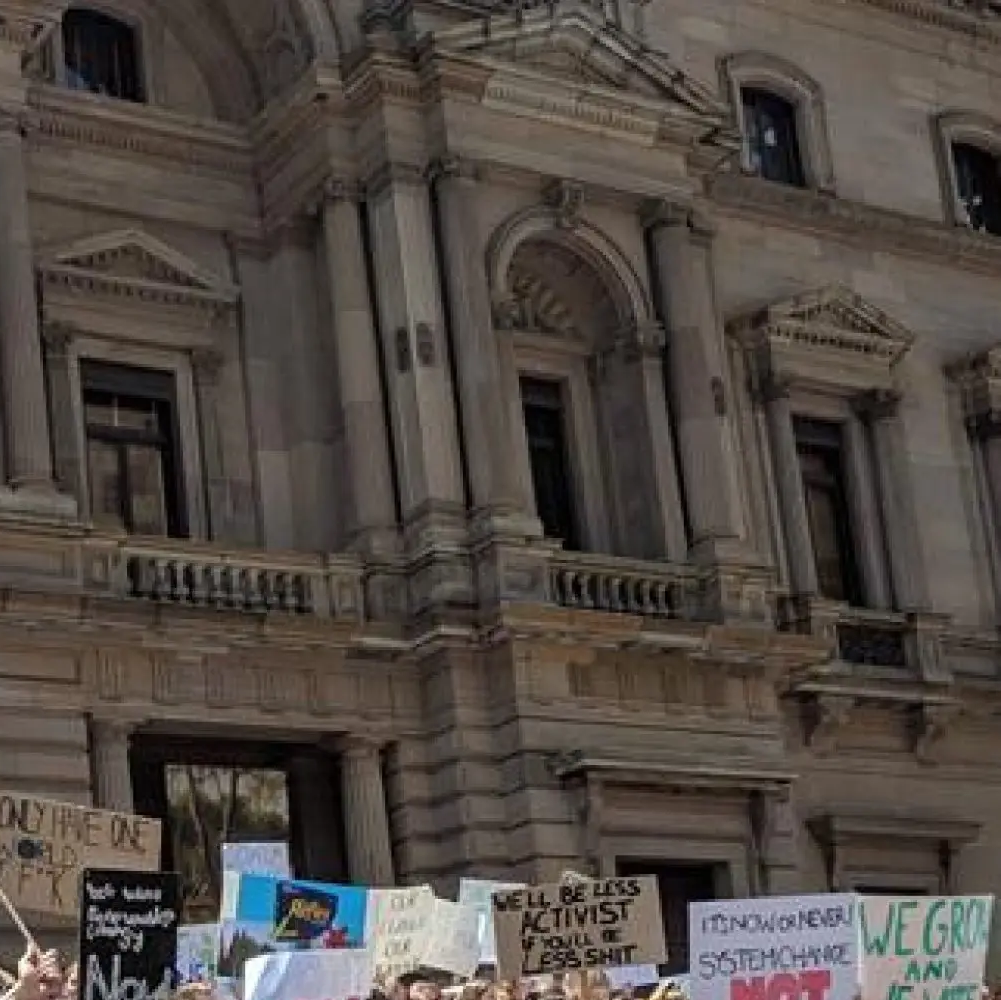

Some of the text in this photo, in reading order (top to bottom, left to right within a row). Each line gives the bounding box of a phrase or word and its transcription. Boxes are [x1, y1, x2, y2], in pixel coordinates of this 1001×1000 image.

[560, 885, 586, 903] BE
[593, 879, 641, 897] LESS
[520, 898, 635, 937] ACTIVIST
[730, 911, 775, 933] NOW
[860, 901, 919, 956] WE
[584, 943, 638, 965] SHIT
[699, 946, 776, 980] SYSTEM
[905, 958, 958, 983] AND
